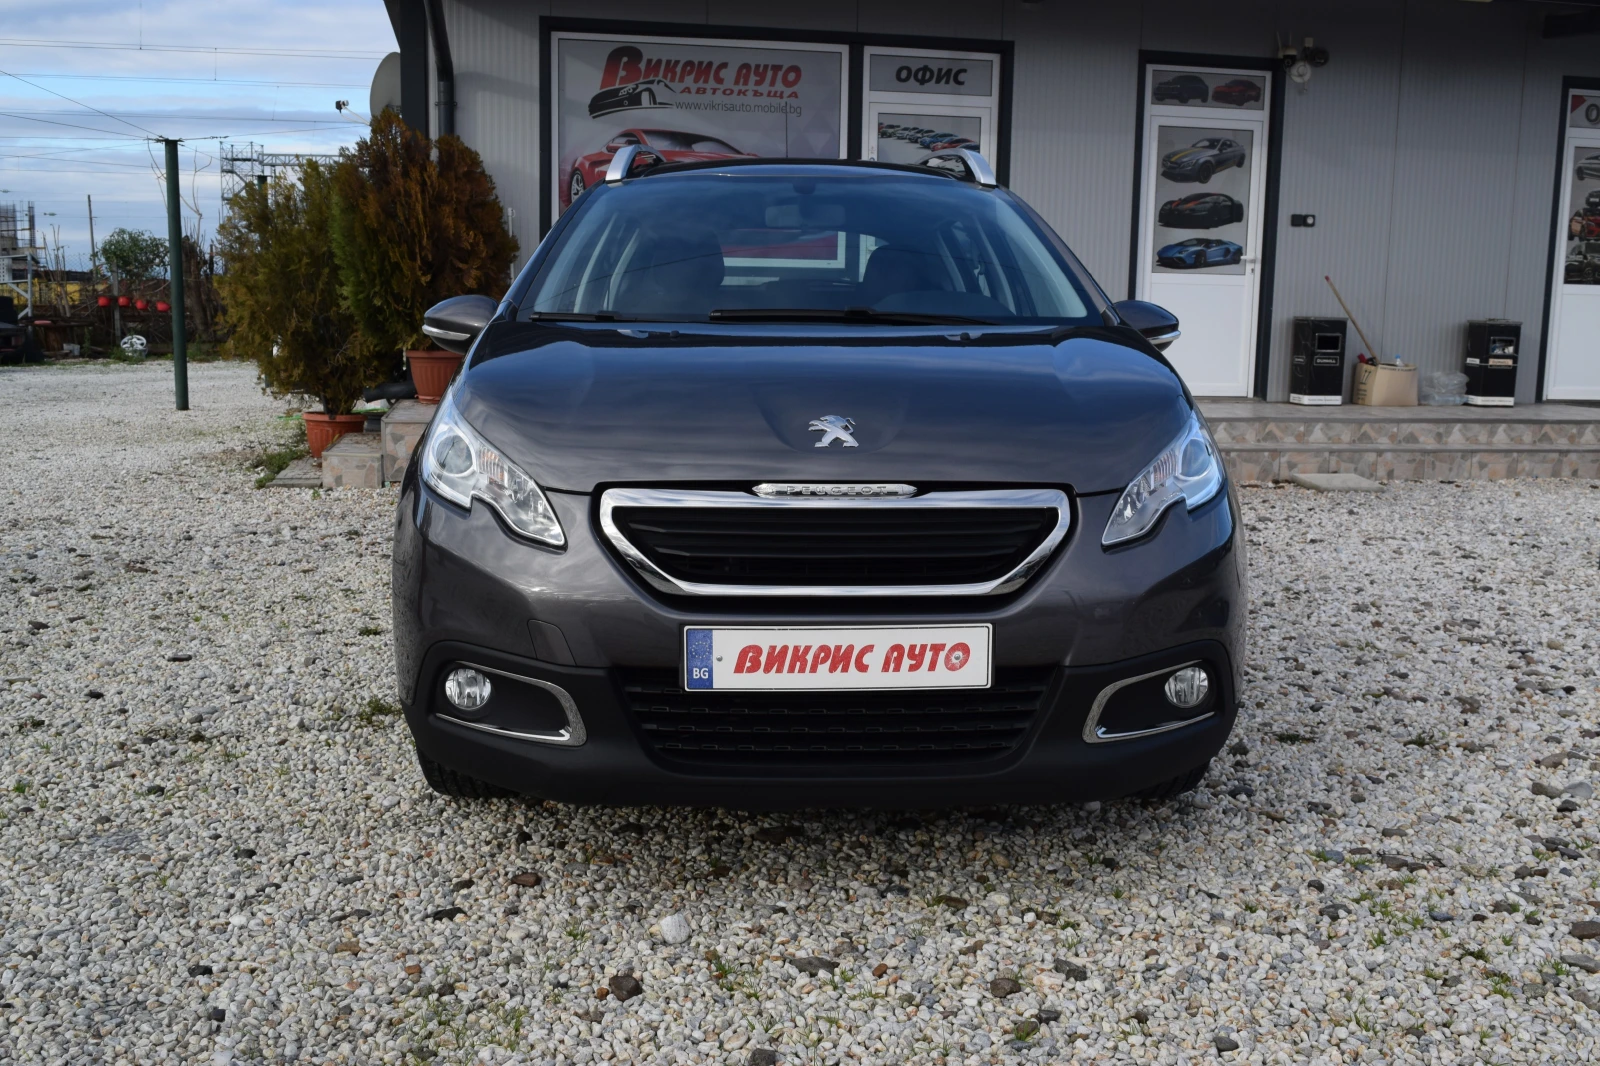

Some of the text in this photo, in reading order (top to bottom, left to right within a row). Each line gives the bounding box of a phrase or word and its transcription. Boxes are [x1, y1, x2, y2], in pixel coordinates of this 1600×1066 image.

[600, 46, 802, 90] ВИКРИС АУТО
[895, 65, 967, 86] ОФИС
[680, 86, 799, 99] АВТОКЪЩА
[675, 101, 802, 117] www.vikrisauto.mobile.bg
[786, 486, 887, 495] PEUGEOT
[733, 642, 971, 674] ВИКРИС АУТО
[692, 667, 709, 679] BG
